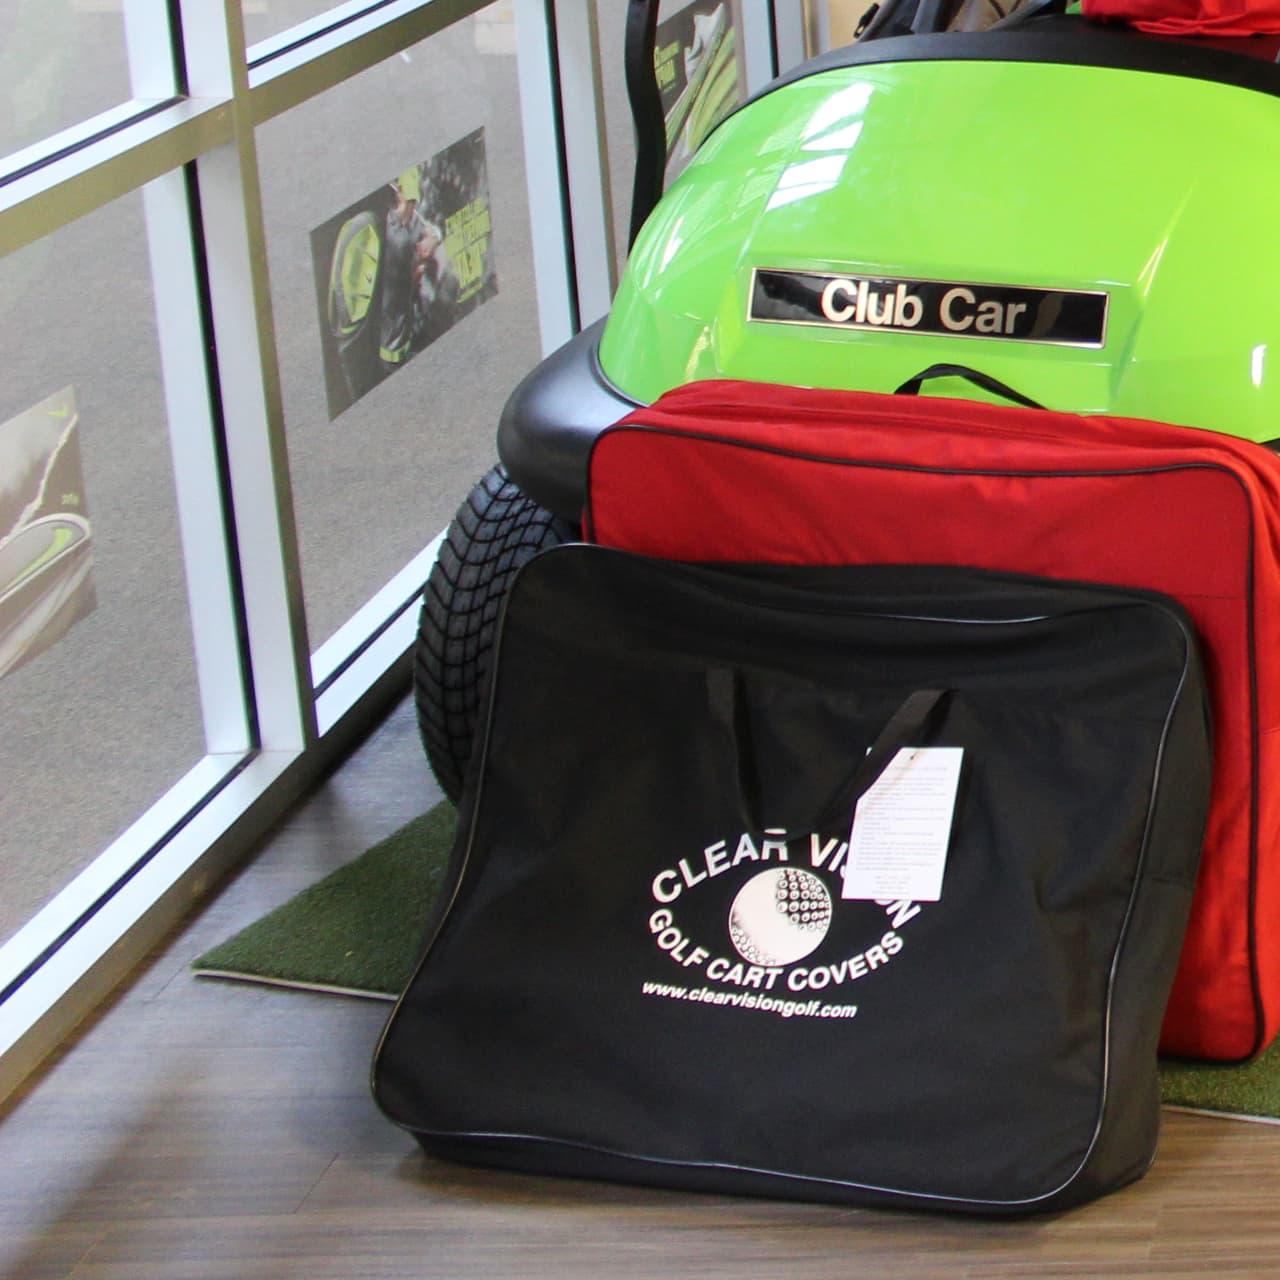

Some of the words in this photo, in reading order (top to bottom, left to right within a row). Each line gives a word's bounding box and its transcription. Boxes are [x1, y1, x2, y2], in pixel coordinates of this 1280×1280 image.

[821, 278, 922, 328] Club
[939, 287, 1026, 335] Car
[652, 828, 789, 903] CLEAR
[811, 833, 921, 929] VIN
[649, 909, 709, 968] GOLF
[705, 957, 783, 990] CART
[787, 930, 904, 991] COVERS
[641, 980, 858, 1018] www.clearvisiongolf.com
